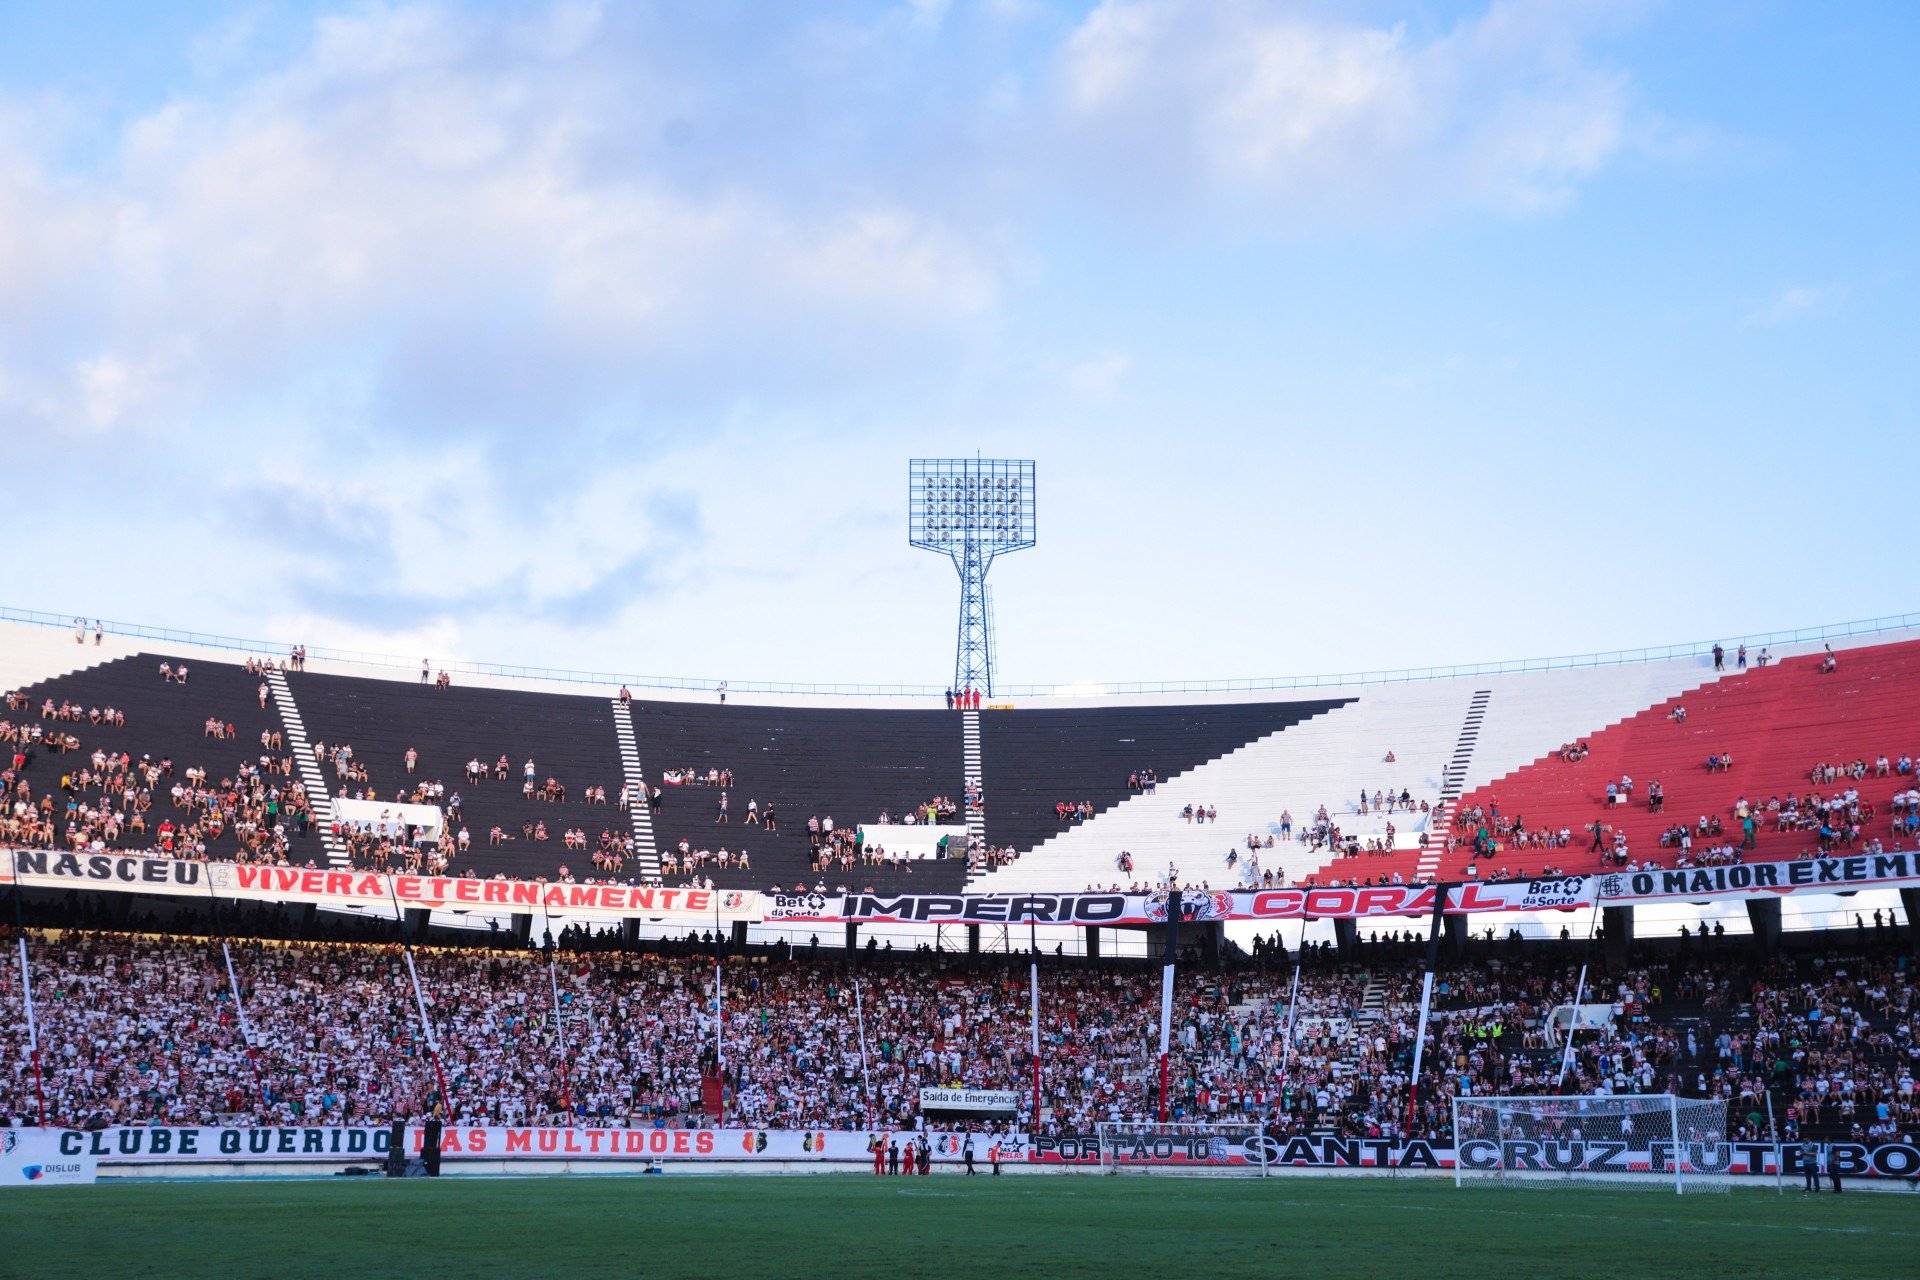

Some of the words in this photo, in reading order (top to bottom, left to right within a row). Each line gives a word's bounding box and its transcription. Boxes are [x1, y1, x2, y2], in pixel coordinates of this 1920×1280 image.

[16, 851, 199, 885] NASCEU
[396, 878, 711, 910] ETERNAMENTE
[1528, 881, 1561, 895] Bet
[1632, 873, 1655, 895] O
[1663, 864, 1779, 893] MAIOR
[775, 895, 804, 907] Bet
[841, 893, 1128, 922] IMPÉRIO
[1252, 883, 1507, 917] CORAL
[1522, 896, 1536, 905] dá
[1537, 895, 1575, 907] Sorte
[771, 909, 784, 917] dá
[785, 910, 820, 918] Sorte
[923, 1091, 949, 1102] Saída
[951, 1093, 962, 1102] de
[965, 1093, 1018, 1105] Emergência
[60, 1129, 200, 1156] CLUBE
[219, 1129, 393, 1154] QUERIDO
[505, 1128, 714, 1154] MULTIDÕES
[1034, 1136, 1174, 1161] PORTÃO
[1186, 1139, 1211, 1161] 10
[1243, 1136, 1442, 1167] SANTA
[1459, 1139, 1628, 1171] CRUZ
[45, 1164, 81, 1173] DISLUB
